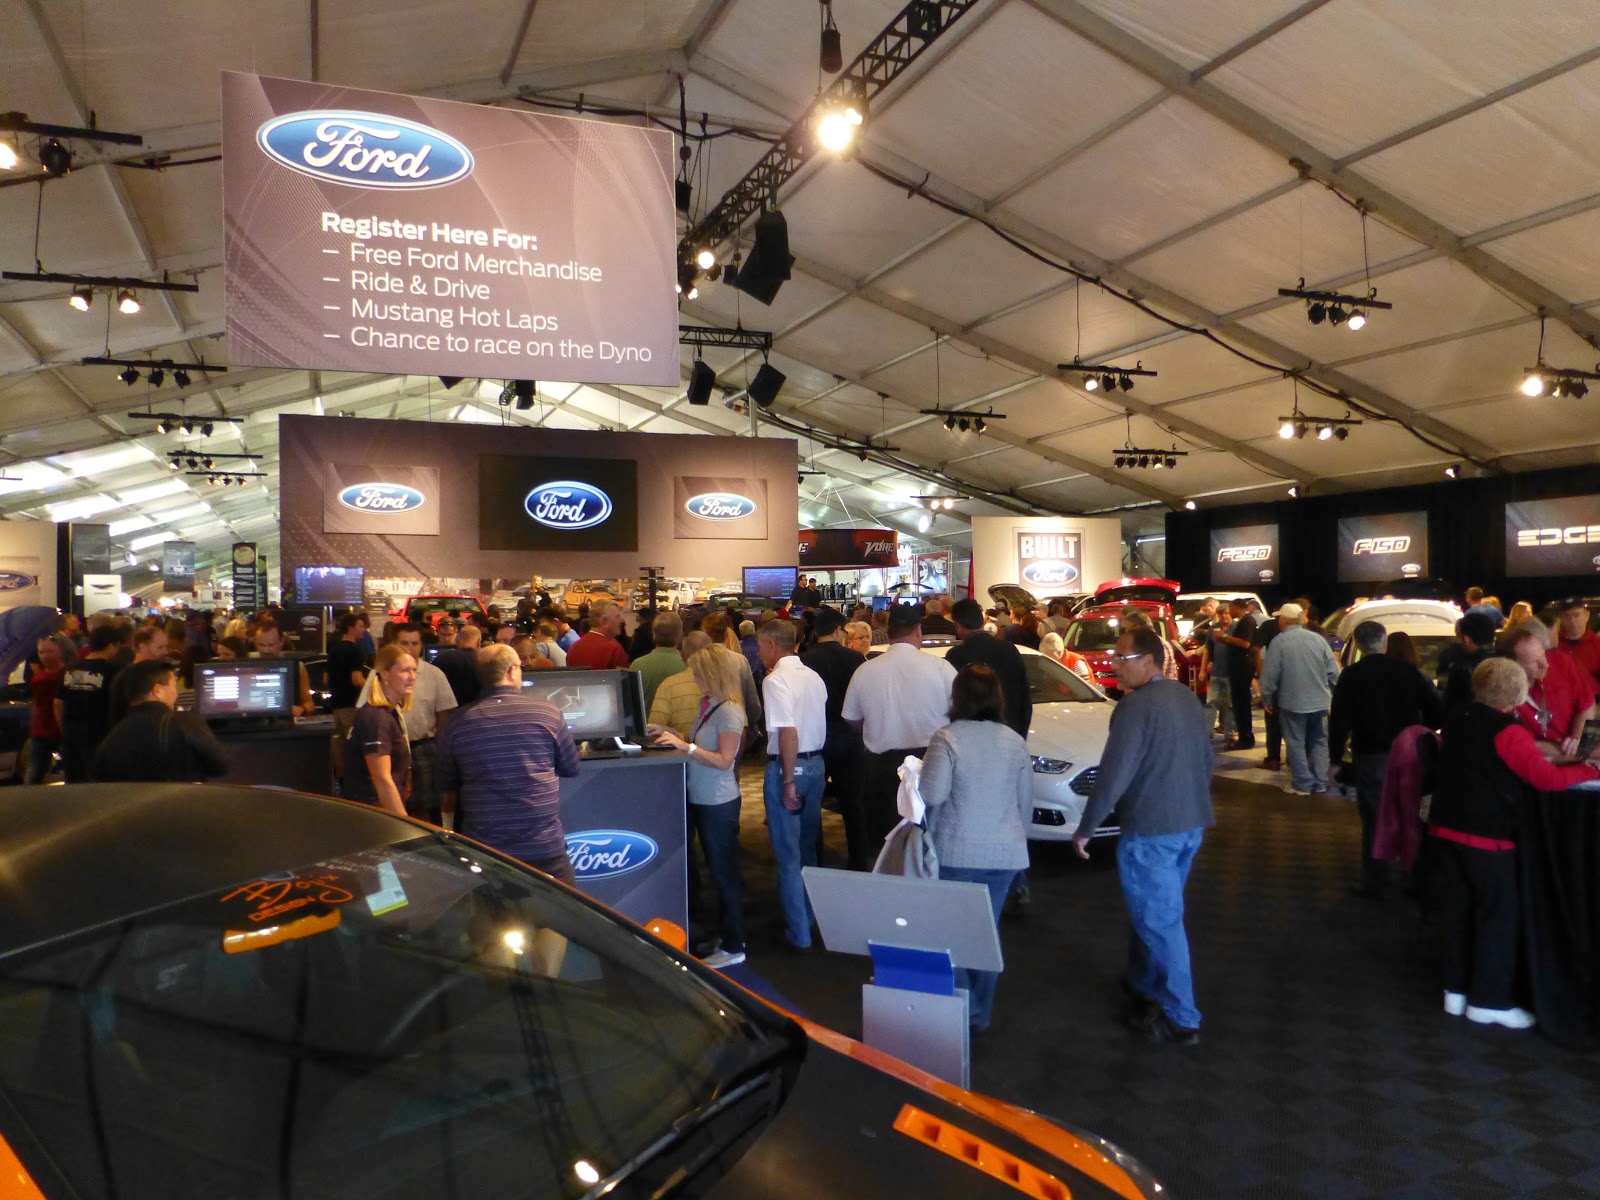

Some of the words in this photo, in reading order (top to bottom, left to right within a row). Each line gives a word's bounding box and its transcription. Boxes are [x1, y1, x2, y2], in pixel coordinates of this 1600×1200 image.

[303, 120, 433, 179] Ford
[321, 211, 428, 240] Register
[431, 222, 489, 247] Here
[492, 227, 538, 251] For:
[350, 242, 402, 266] Free
[407, 247, 459, 271] Ford
[464, 252, 603, 282] Merchandise
[351, 270, 404, 294] Ride
[409, 274, 428, 295] &
[434, 276, 491, 300] Drive
[351, 297, 454, 328] Mustang
[459, 305, 501, 328] Hot
[506, 308, 559, 333] Laps
[350, 326, 441, 351] Chance
[445, 332, 469, 353] to
[474, 338, 521, 355] race
[526, 340, 554, 357] on
[559, 338, 594, 359] the
[599, 341, 652, 364] Dyno
[355, 486, 409, 509] Ford
[535, 490, 587, 522] Ford
[698, 496, 743, 516] Ford
[1020, 536, 1078, 559] BUILT
[1217, 544, 1272, 563] F-250
[1352, 535, 1411, 555] F-150
[565, 838, 632, 871] Ford
